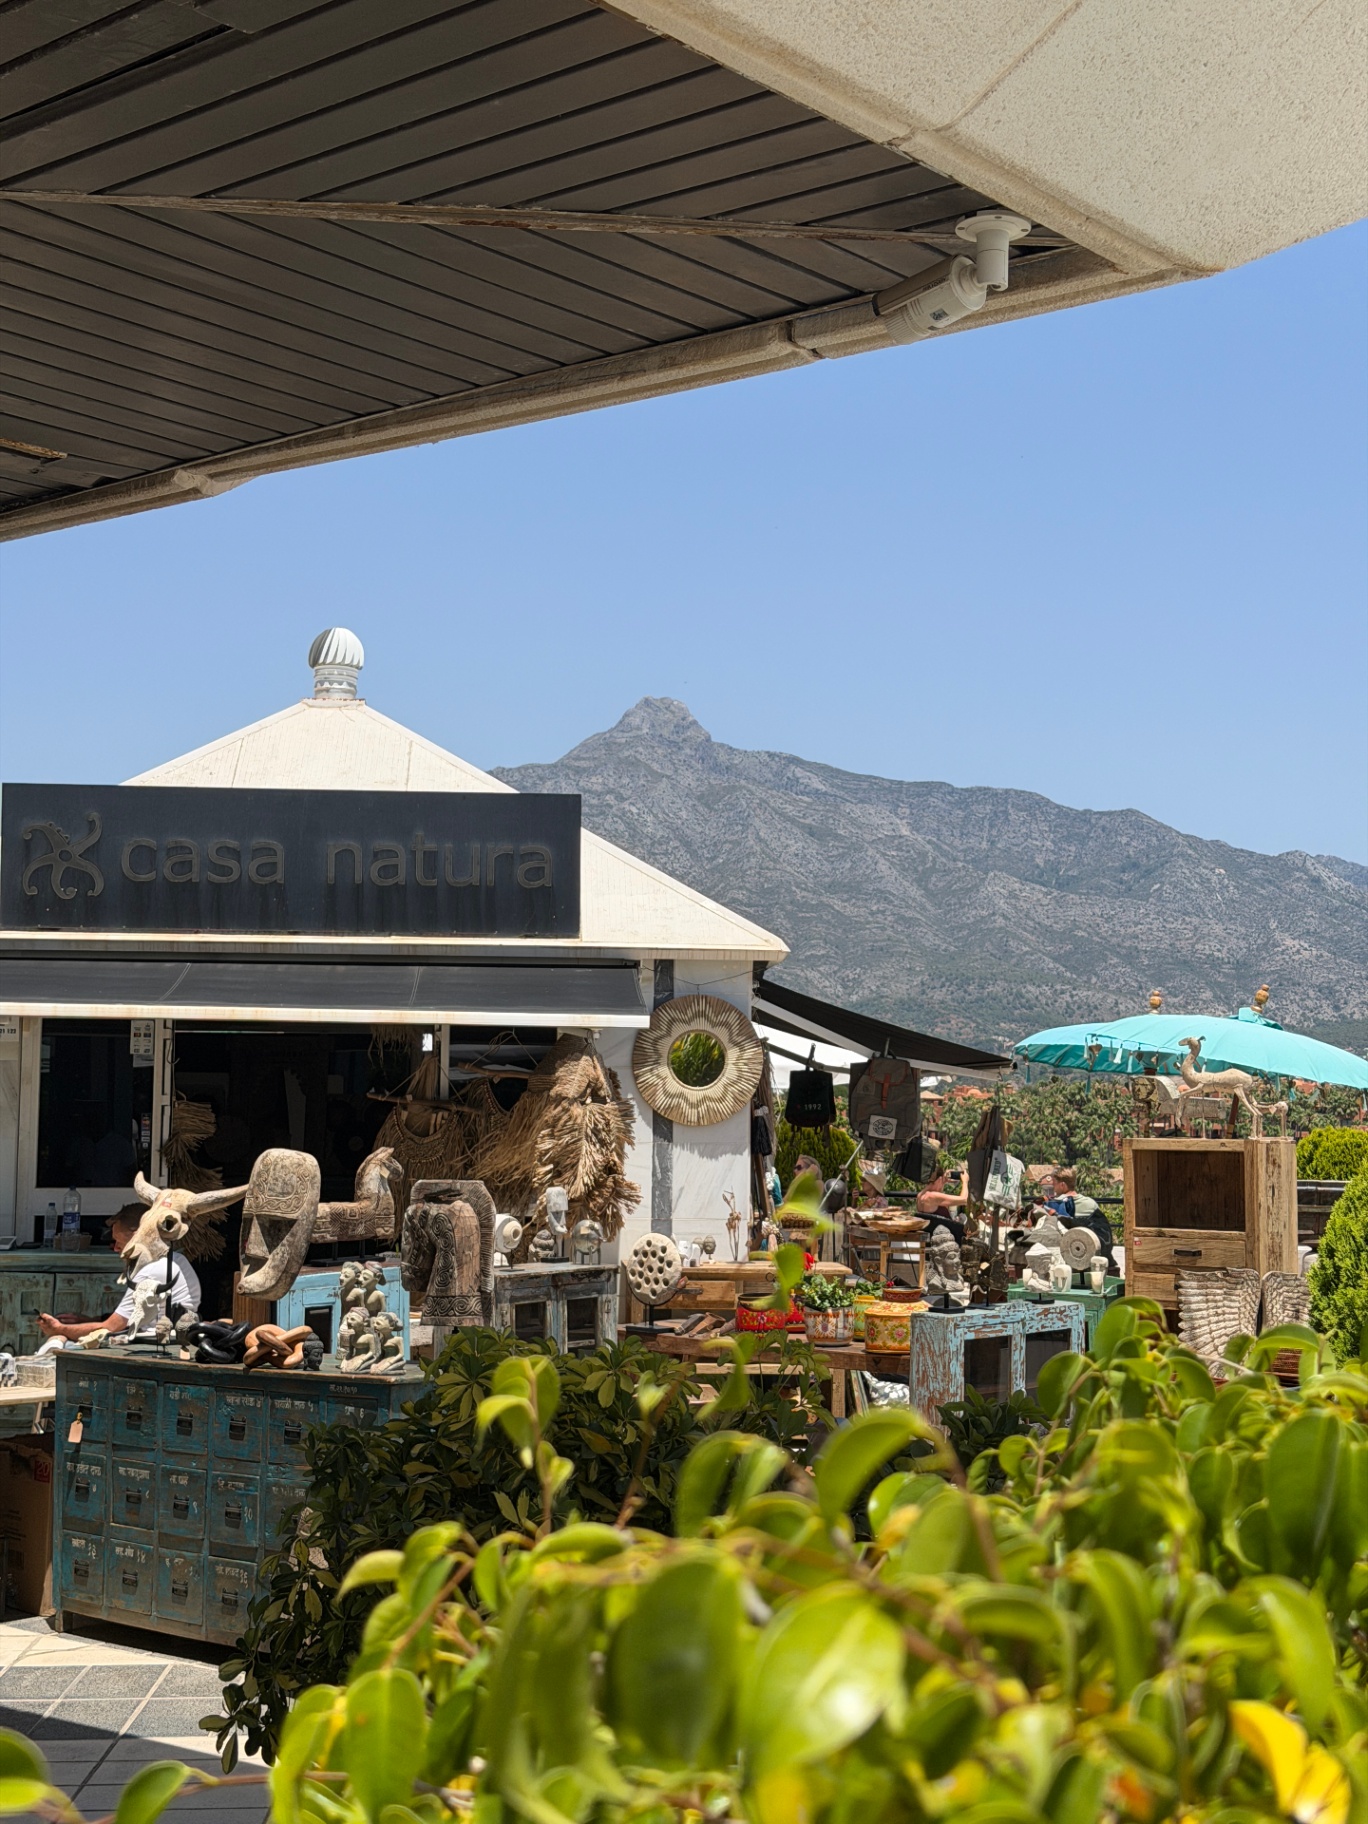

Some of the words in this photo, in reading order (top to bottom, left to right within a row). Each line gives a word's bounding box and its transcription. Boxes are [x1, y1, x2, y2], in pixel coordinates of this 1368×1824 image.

[121, 837, 285, 885] casa
[327, 832, 552, 888] natura
[804, 1103, 822, 1111] 1992
[36, 1461, 50, 1476] 20
